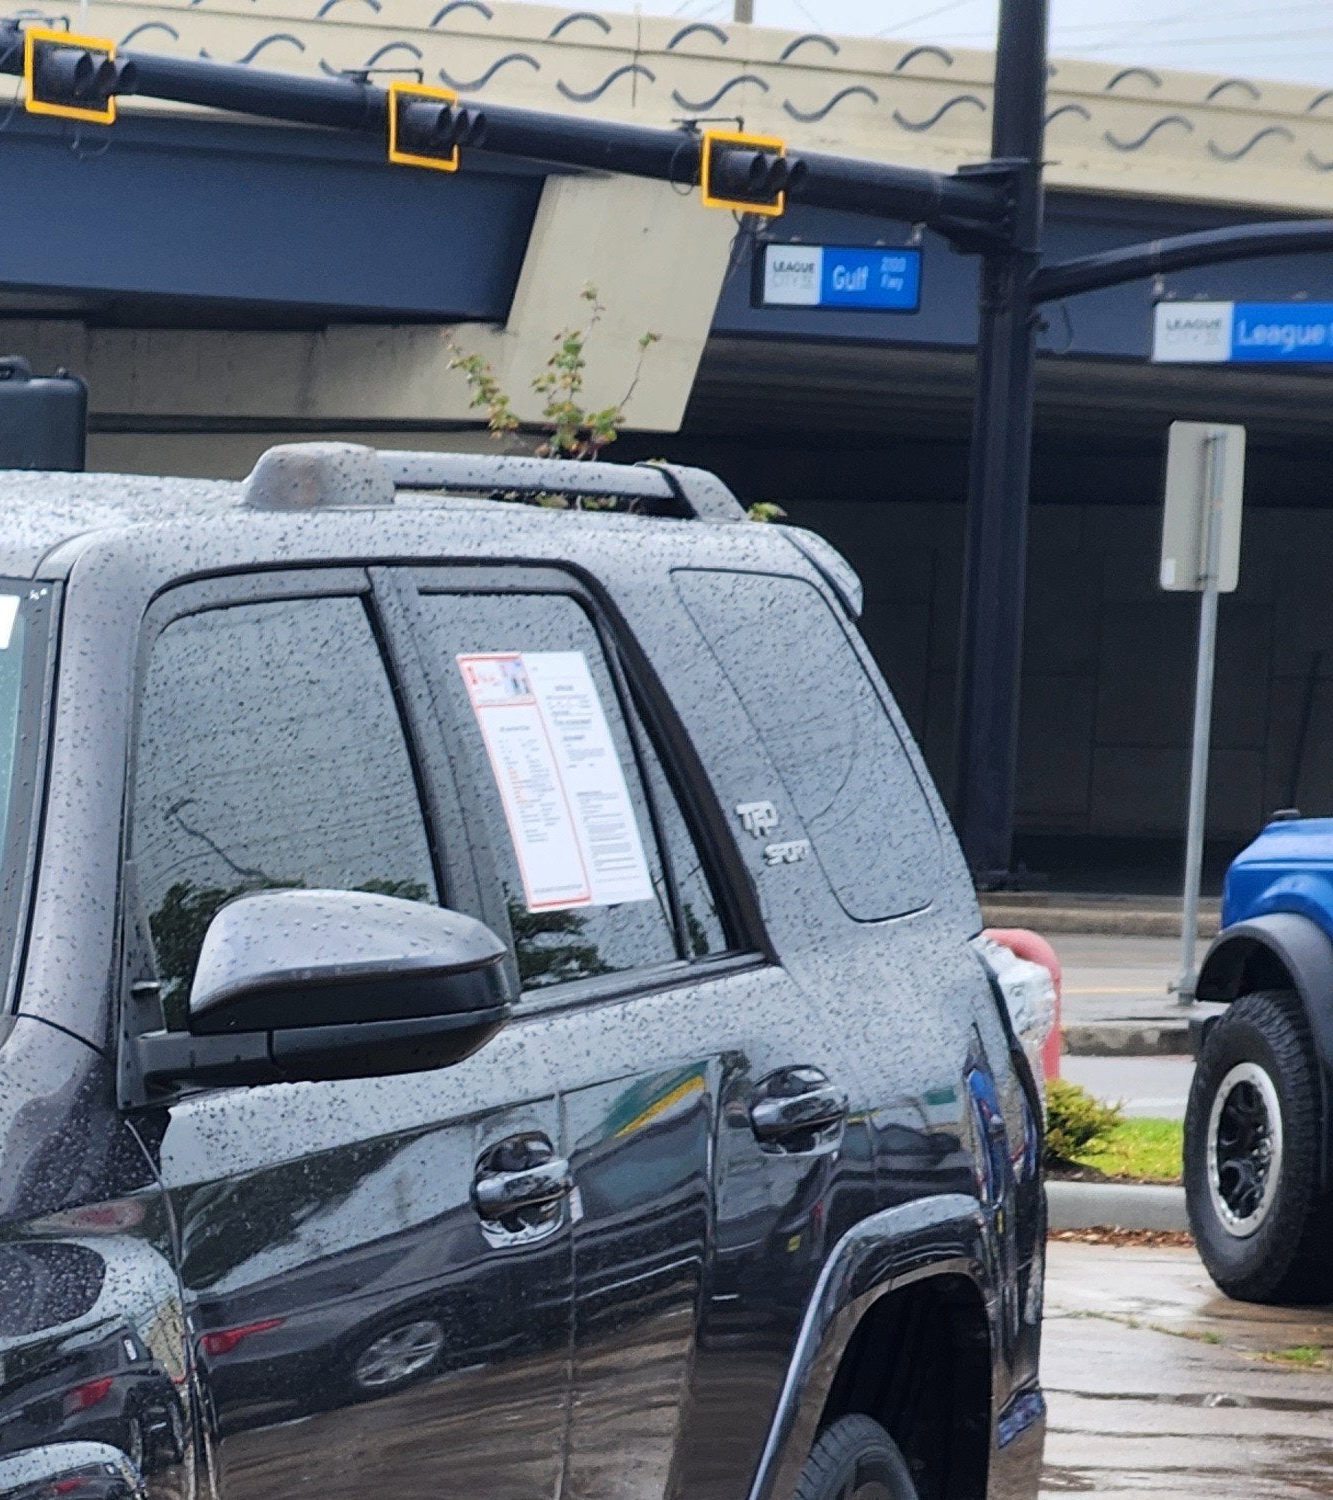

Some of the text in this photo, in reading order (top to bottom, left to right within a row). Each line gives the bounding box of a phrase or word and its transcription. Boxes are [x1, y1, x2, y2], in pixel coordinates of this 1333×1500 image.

[772, 260, 815, 273] LEAGUE
[832, 264, 870, 291] Gulf
[1166, 317, 1221, 331] LEAGUE
[1237, 318, 1325, 354] League
[736, 800, 779, 838] TRD
